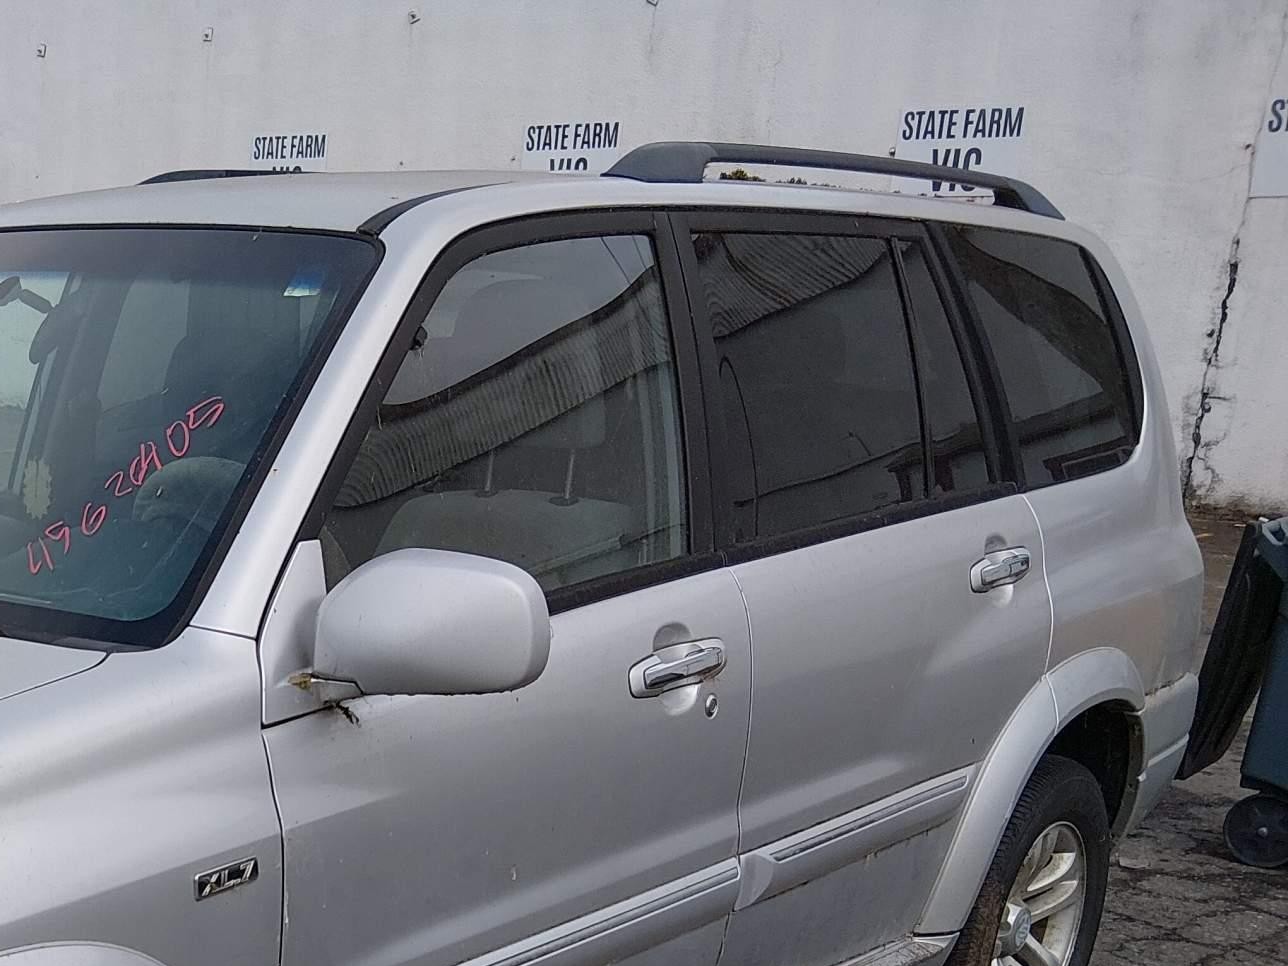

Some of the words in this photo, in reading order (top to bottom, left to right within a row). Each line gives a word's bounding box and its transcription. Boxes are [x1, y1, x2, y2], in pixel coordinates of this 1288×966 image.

[525, 123, 570, 152] STATE
[572, 121, 620, 150] FARM
[901, 109, 959, 141] STATE
[962, 106, 1025, 139] FARM
[253, 135, 288, 160] STATE
[289, 134, 327, 159] FARM
